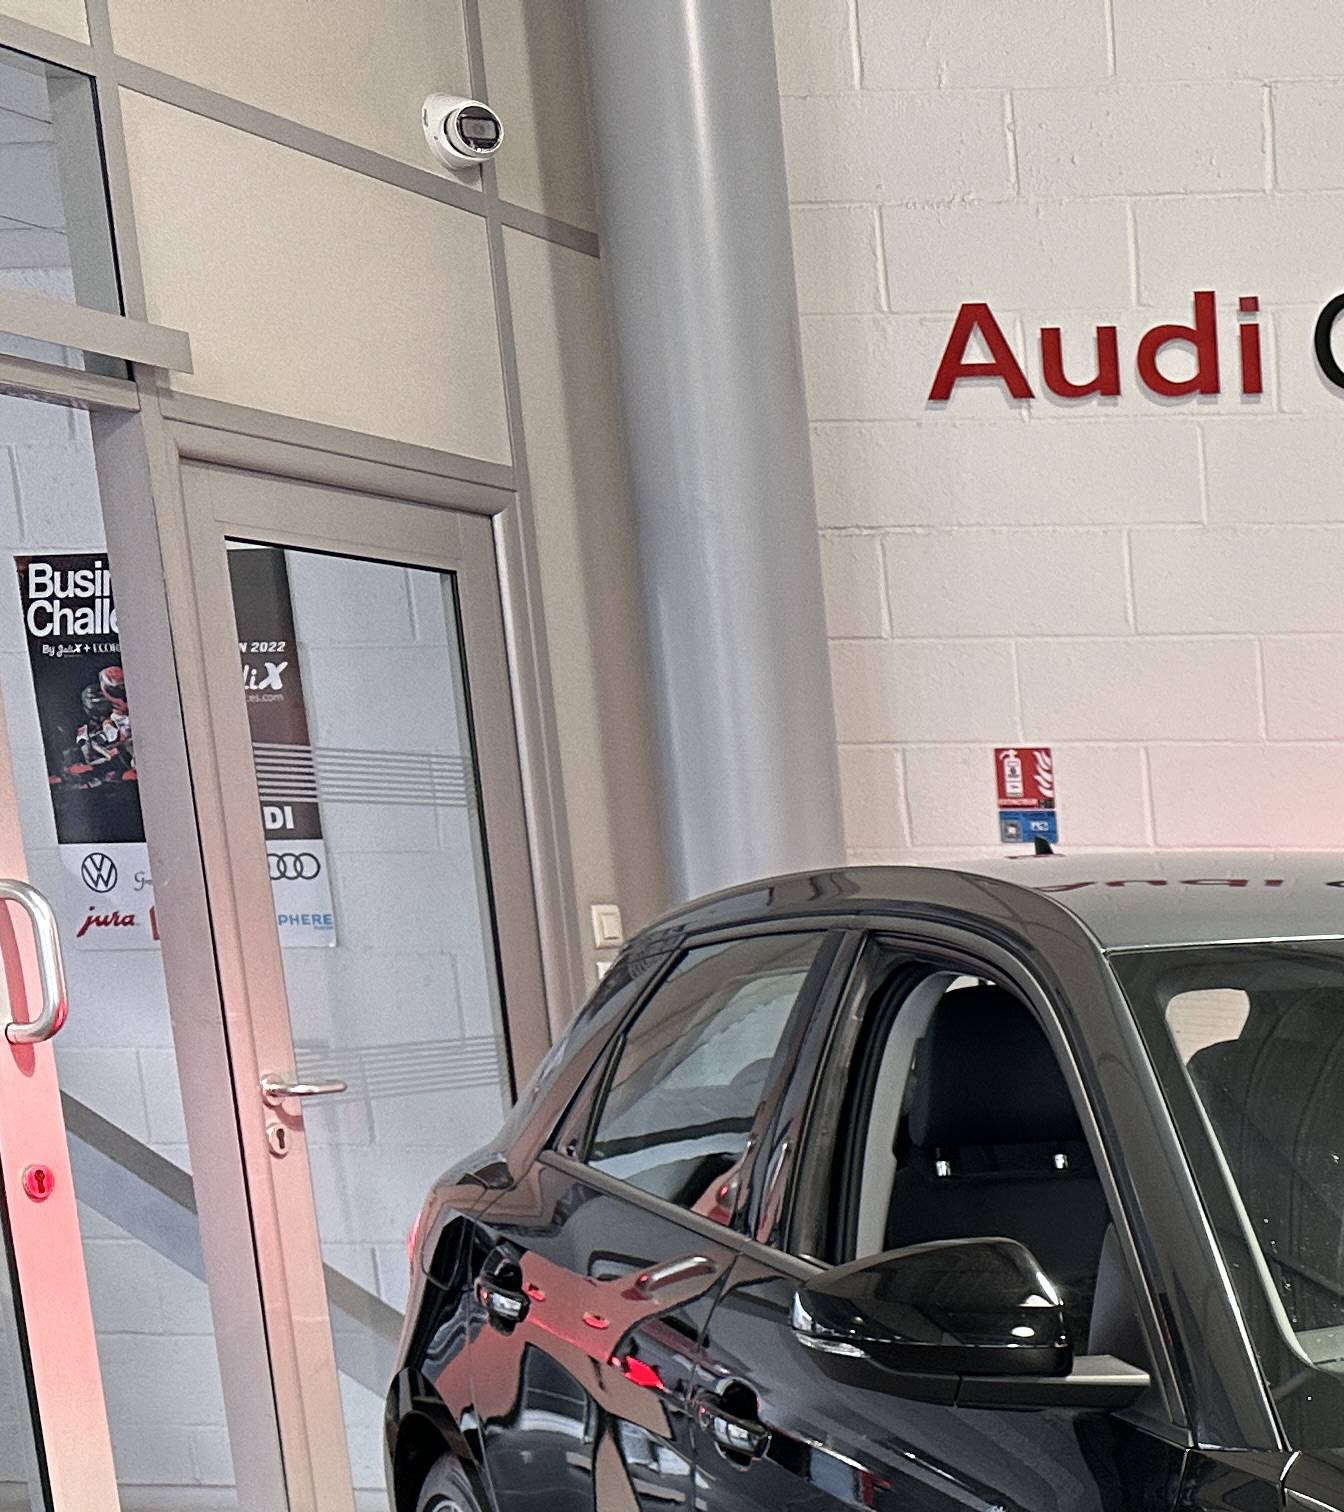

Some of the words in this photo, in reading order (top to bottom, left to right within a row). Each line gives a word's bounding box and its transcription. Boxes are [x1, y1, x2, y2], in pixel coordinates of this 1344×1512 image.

[927, 290, 1264, 401] Audi
[250, 641, 286, 653] 2022
[76, 905, 135, 938] jura
[278, 914, 333, 926] PHERE
